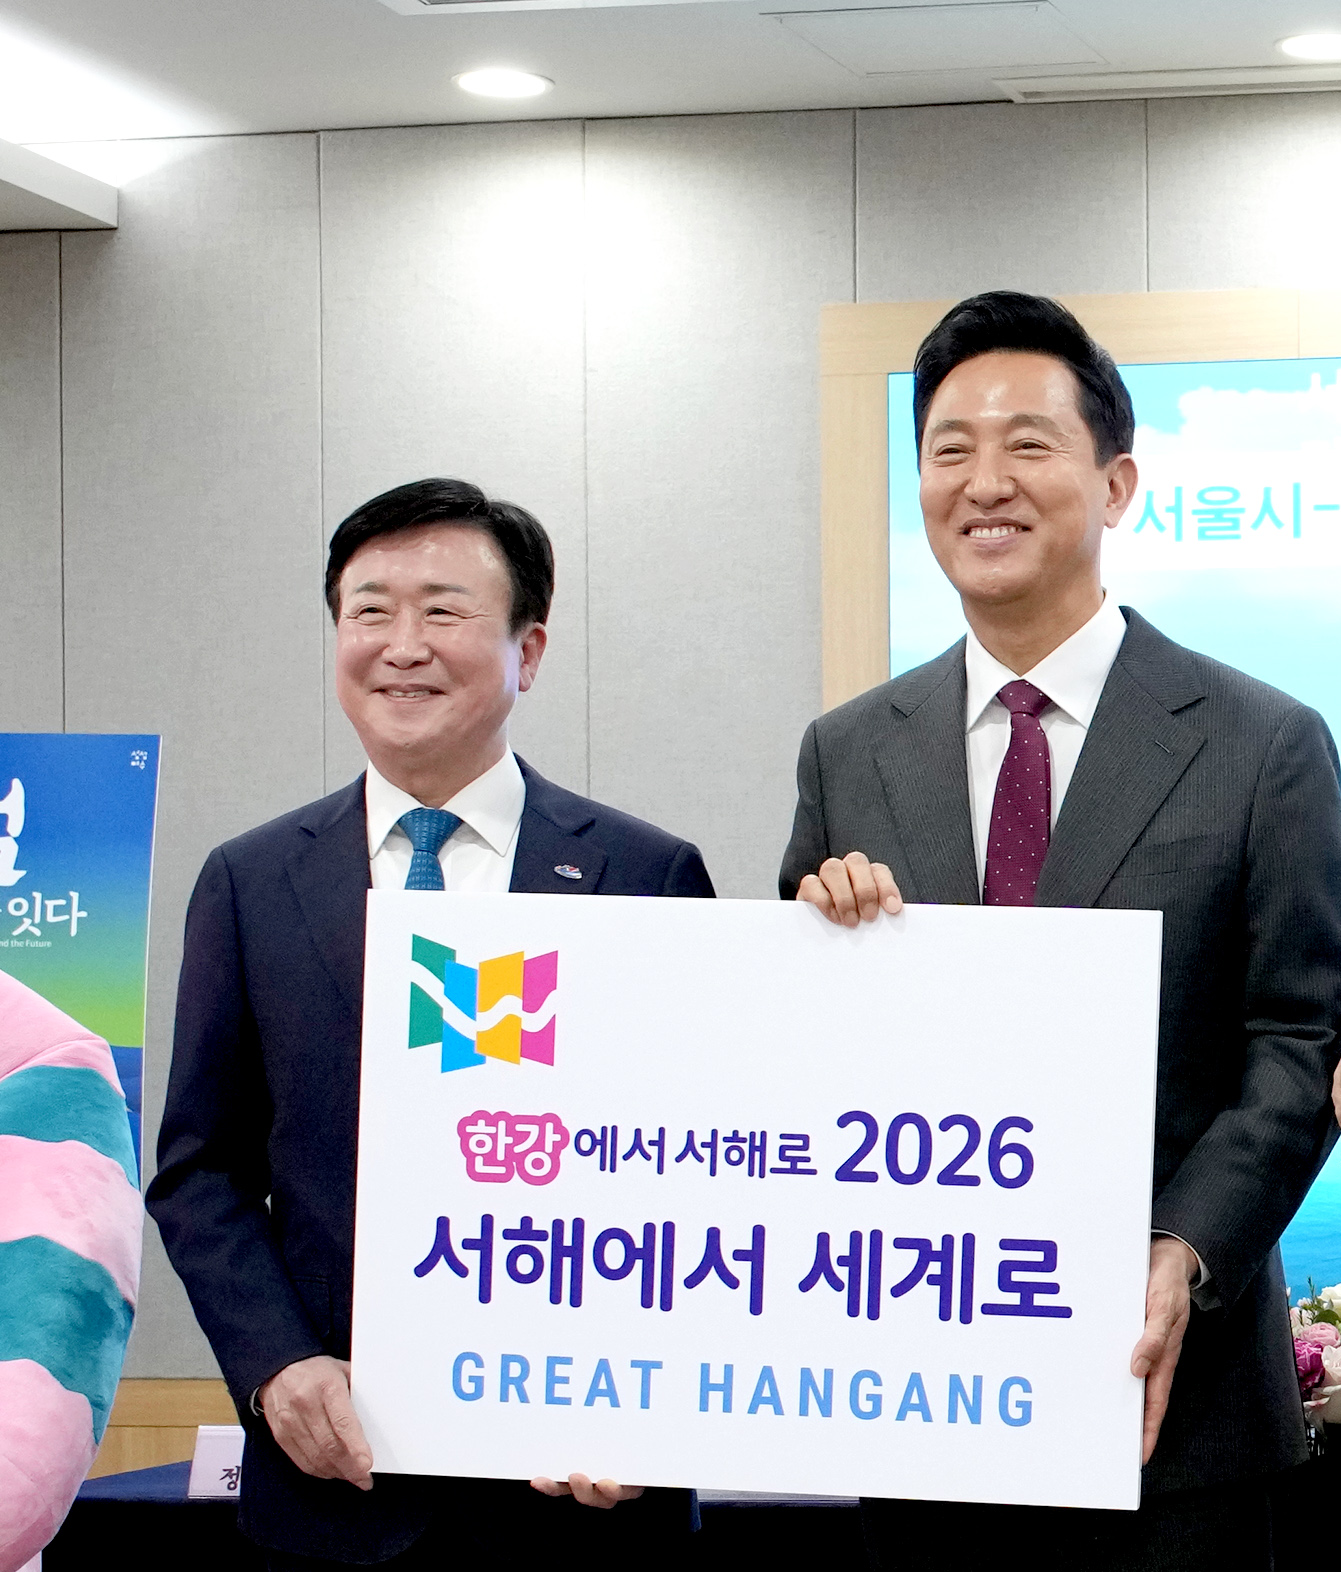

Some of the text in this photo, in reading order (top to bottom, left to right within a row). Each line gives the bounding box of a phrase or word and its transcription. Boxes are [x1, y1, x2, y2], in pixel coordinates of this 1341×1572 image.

[7, 890, 88, 937] 잇다
[11, 940, 24, 948] the
[25, 940, 52, 948] Future
[834, 1110, 1035, 1190] 2026
[413, 1213, 1073, 1325] 서해에서 세계로
[451, 1351, 1033, 1428] GREAT HANGANG
